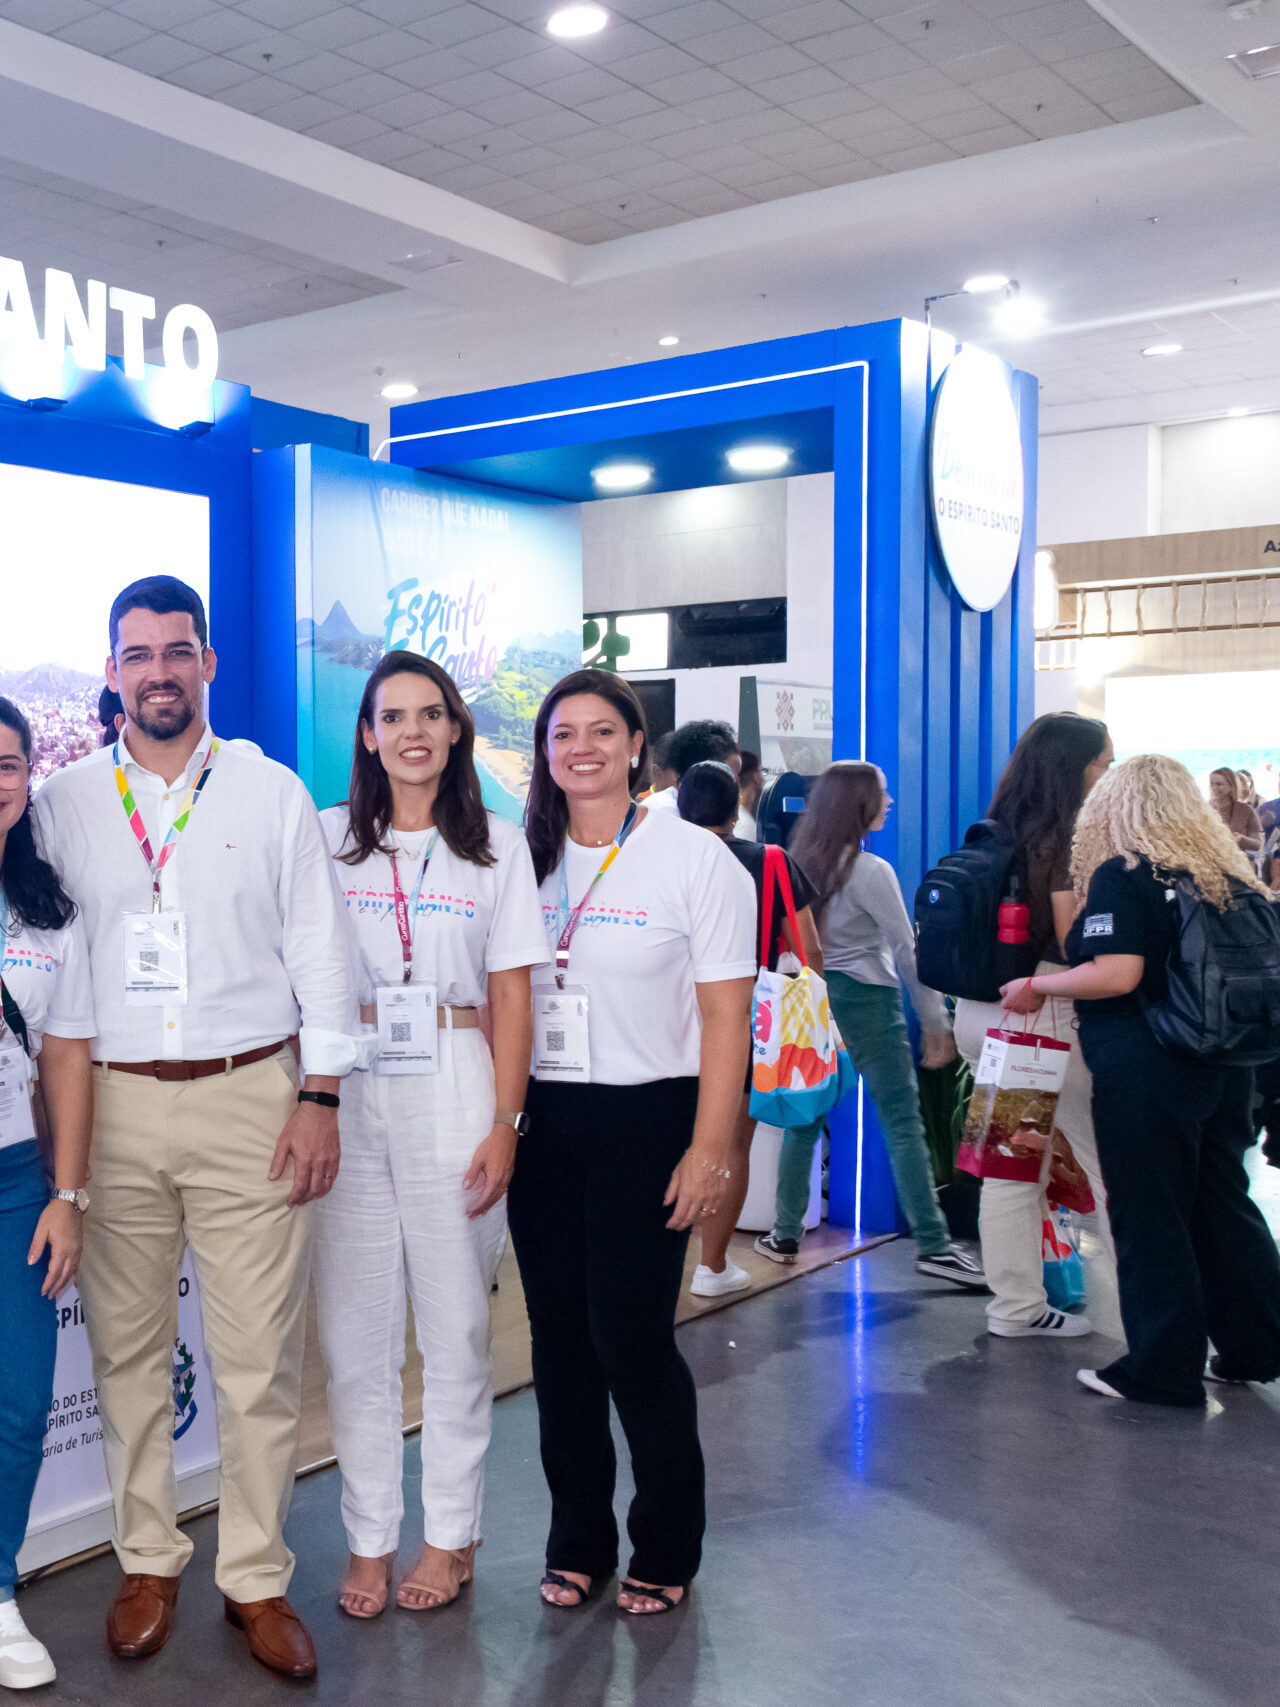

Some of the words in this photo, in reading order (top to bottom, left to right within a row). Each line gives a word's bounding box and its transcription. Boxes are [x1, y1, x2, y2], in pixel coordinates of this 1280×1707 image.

[381, 487, 439, 521] CARIBE?
[441, 498, 467, 527] QUE
[470, 504, 509, 535] NADA!
[938, 497, 945, 516] O
[948, 498, 988, 527] ESPÍRITO
[990, 510, 1020, 535] SANTO
[63, 1394, 77, 1409] DO
[65, 1436, 77, 1451] de
